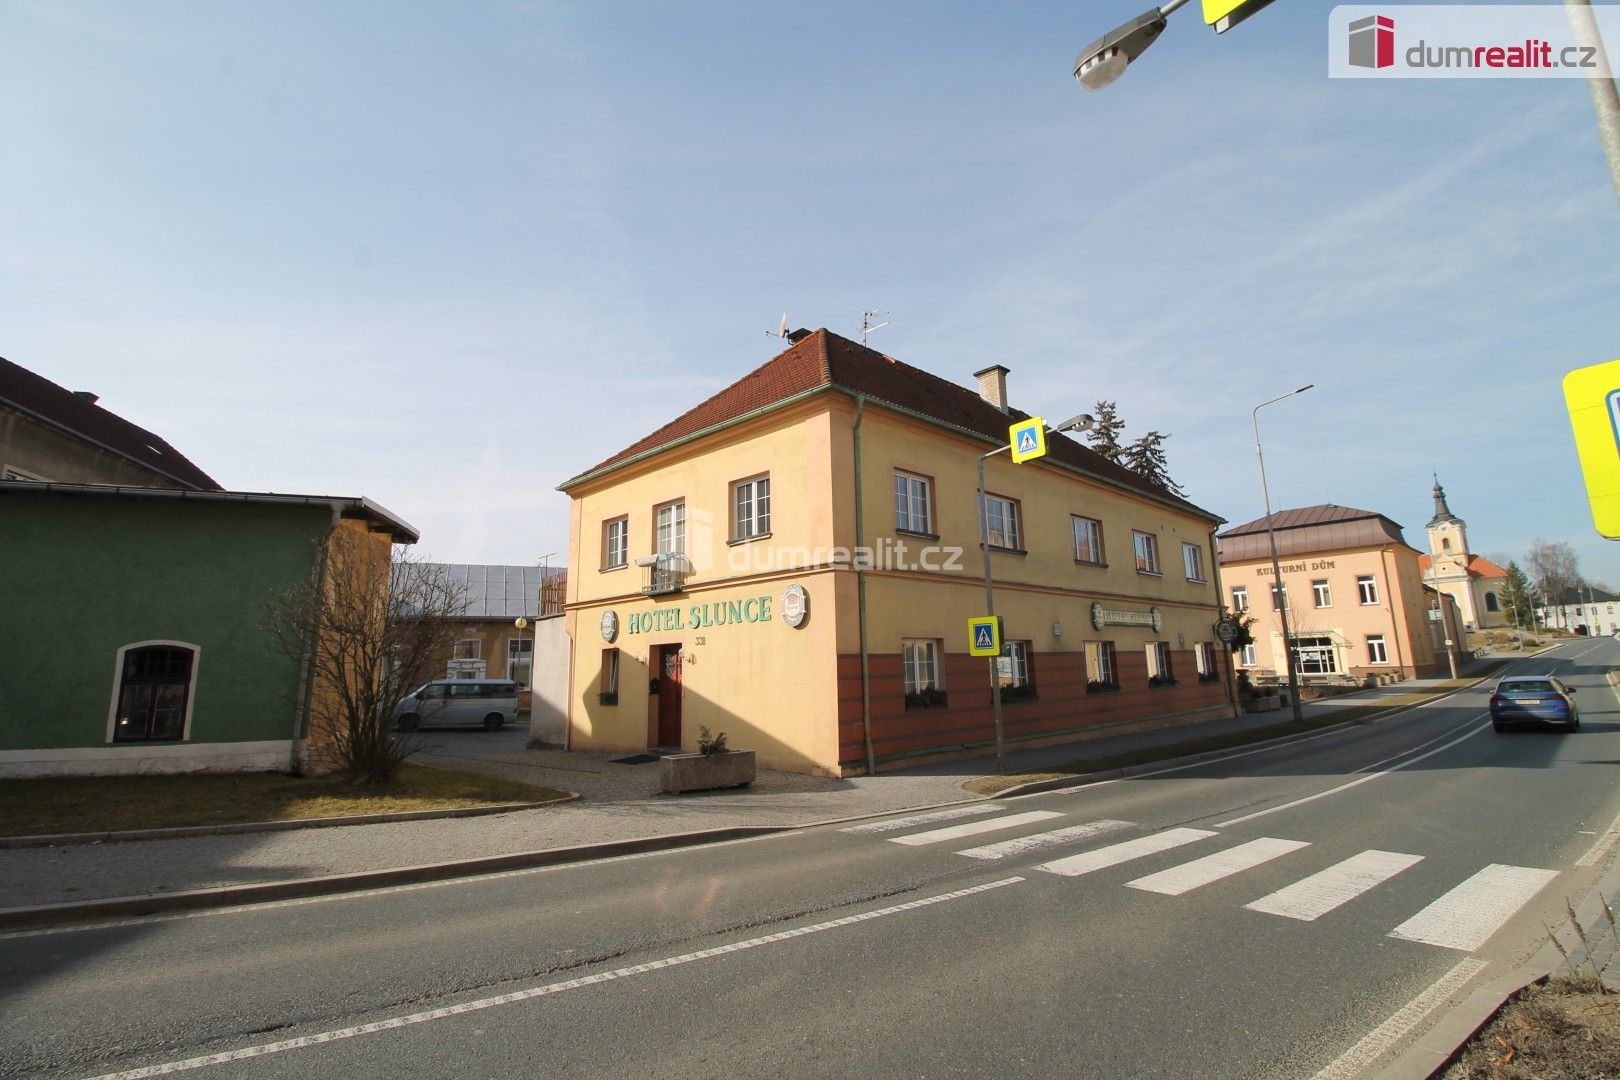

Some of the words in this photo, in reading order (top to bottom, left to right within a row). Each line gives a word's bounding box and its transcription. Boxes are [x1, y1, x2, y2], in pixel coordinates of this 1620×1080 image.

[1312, 559, 1335, 571] DŮM
[628, 607, 684, 634] HOTEL
[688, 595, 773, 629] SLUNCE
